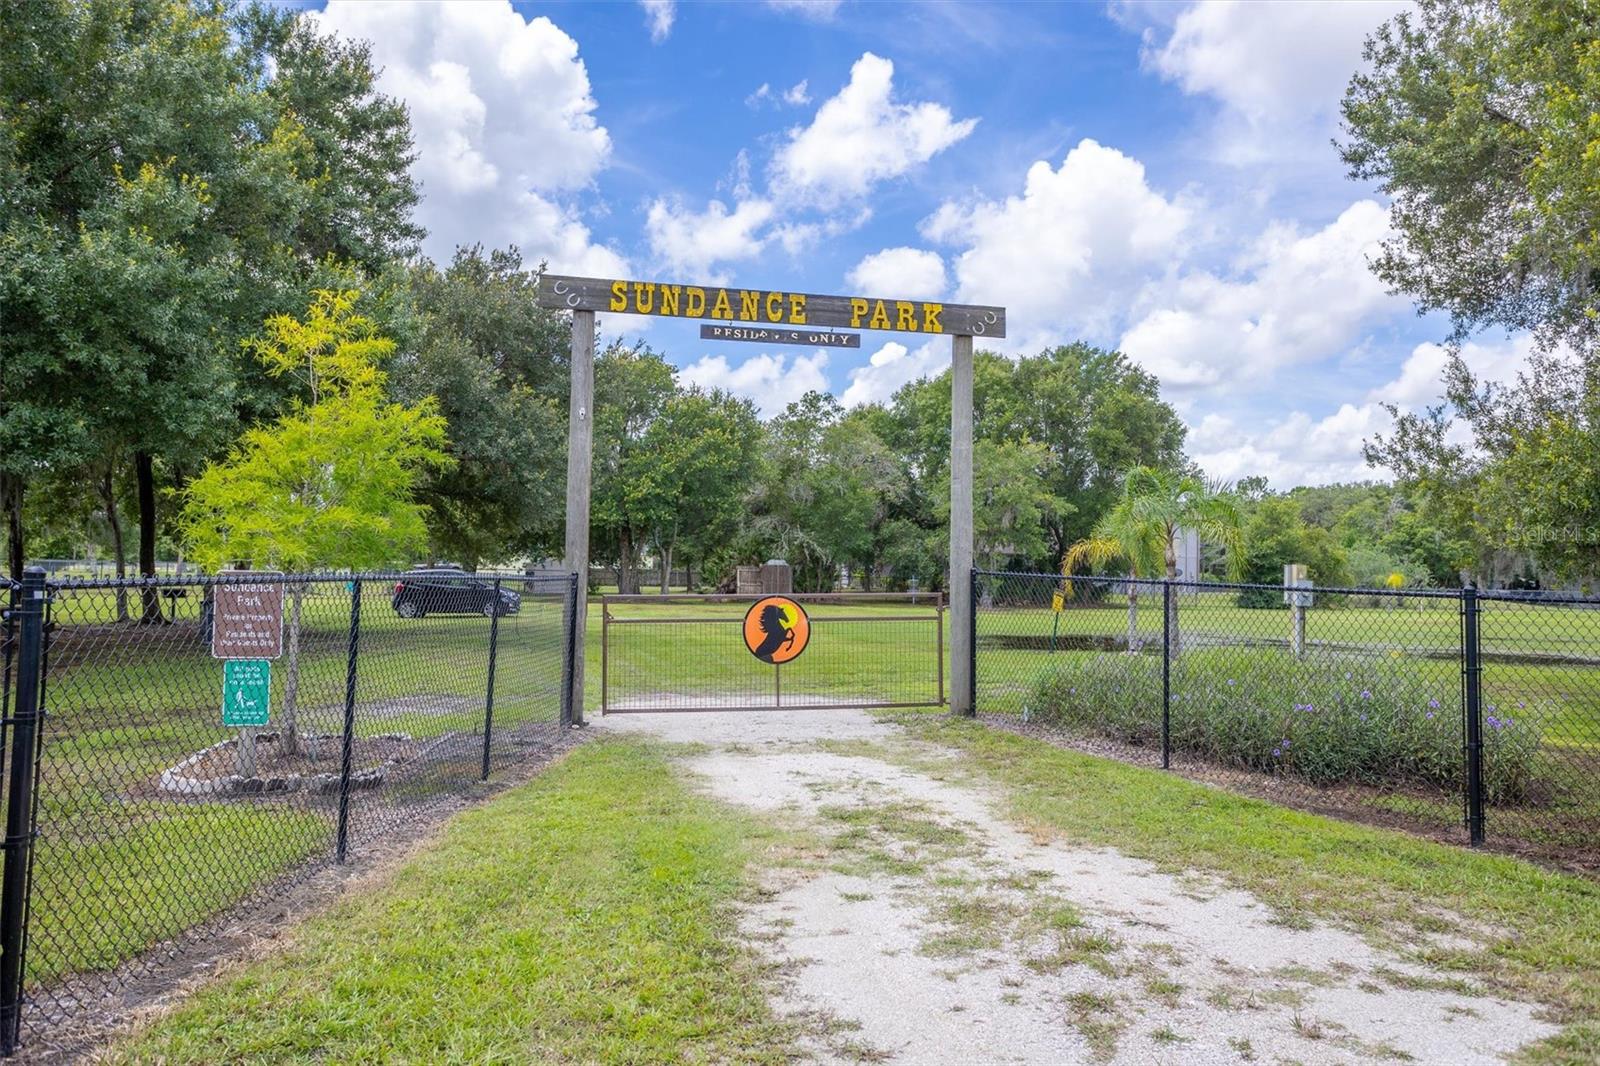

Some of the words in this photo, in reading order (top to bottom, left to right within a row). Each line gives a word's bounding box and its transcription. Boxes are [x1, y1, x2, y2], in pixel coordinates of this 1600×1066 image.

[609, 281, 806, 324] SUNDANCE
[850, 298, 944, 333] PARK
[237, 595, 262, 606] Park
